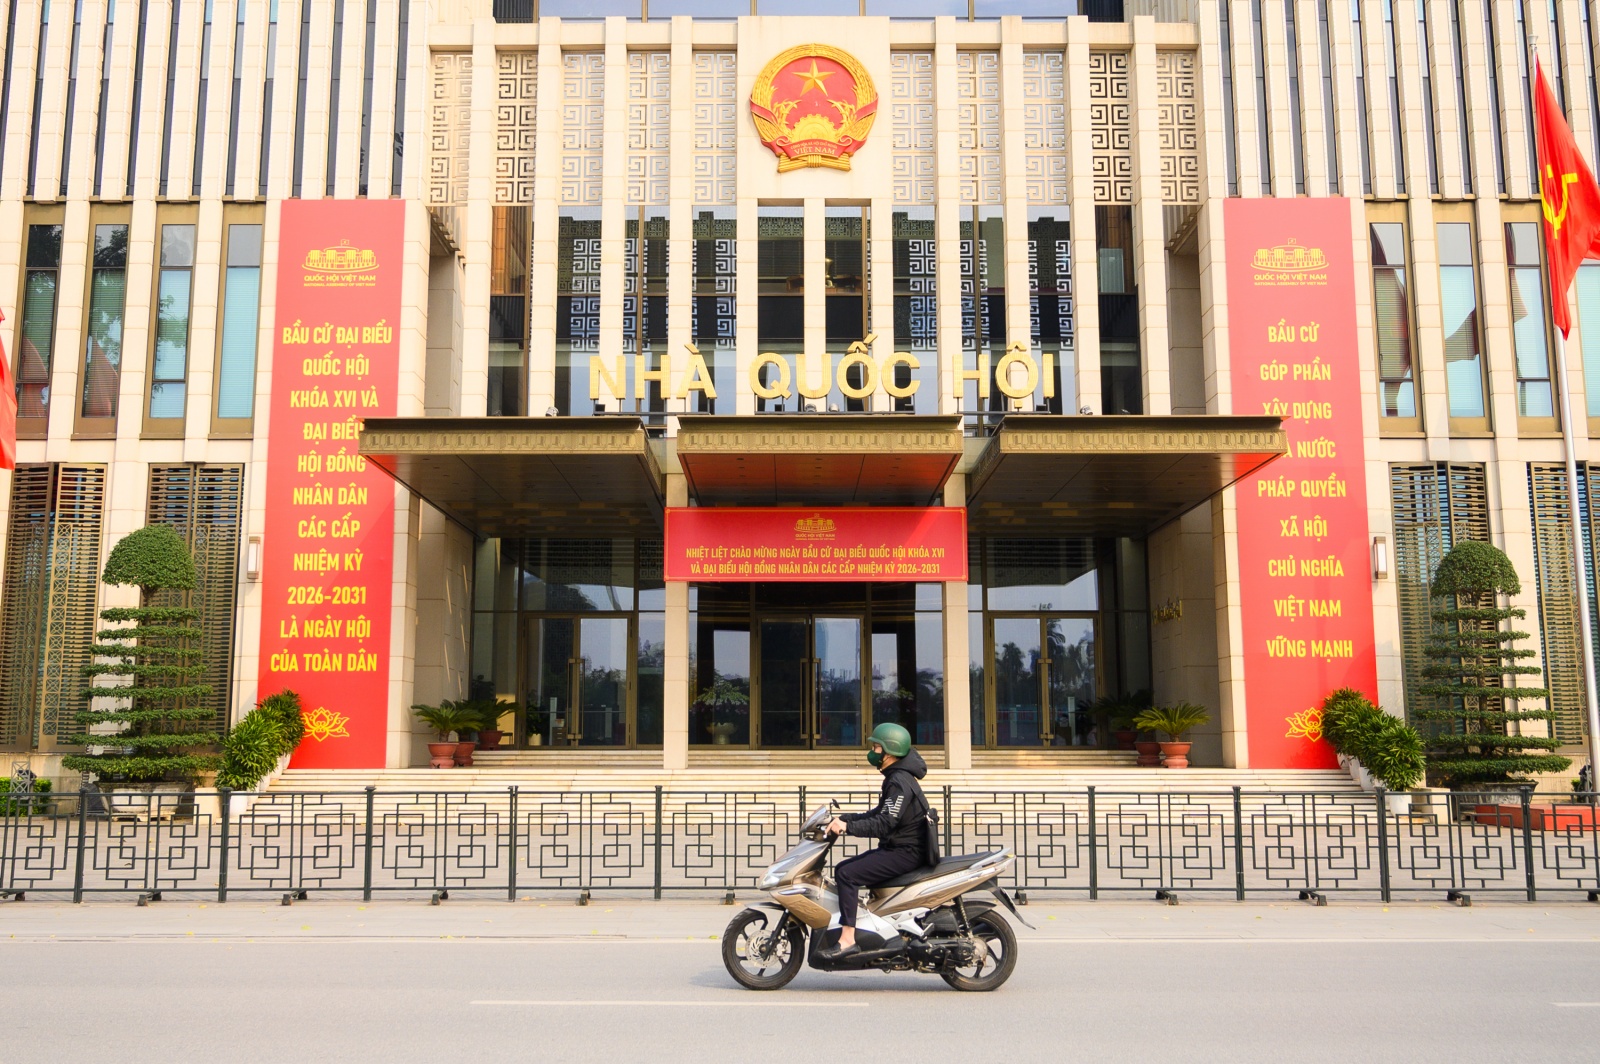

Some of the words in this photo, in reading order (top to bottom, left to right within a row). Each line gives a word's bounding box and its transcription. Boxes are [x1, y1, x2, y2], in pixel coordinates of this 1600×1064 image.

[814, 147, 835, 155] NAM
[304, 273, 325, 281] QUỐC
[326, 274, 339, 282] HỘI
[340, 274, 357, 282] VIỆT
[1254, 272, 1275, 280] QUỐC
[1276, 273, 1290, 281] HỘI
[1291, 273, 1308, 281] VIỆT
[283, 320, 309, 344] BẦU
[313, 322, 333, 344] CỬ
[336, 327, 358, 348] ĐẠI
[362, 320, 392, 344] BIỂU
[1268, 319, 1295, 342] BẦU
[1300, 321, 1320, 342] CỬ
[302, 351, 341, 376] QUỐC
[346, 354, 369, 380] HỘI
[589, 344, 718, 400] NHÀ
[748, 333, 921, 399] QUỐC
[952, 341, 1054, 408] HỘI
[1260, 360, 1288, 380] GÓP
[1293, 356, 1331, 380] PHẦN
[290, 386, 328, 407] KHÓA
[334, 390, 356, 407] XVI
[361, 386, 378, 407] VÀ
[1293, 401, 1332, 424] DỰNG
[303, 422, 327, 444] ĐẠI
[1297, 436, 1336, 458] NƯỚC
[298, 450, 322, 476] HỘI
[293, 483, 333, 504] NHÂN
[338, 483, 367, 505] DÂN
[1258, 476, 1296, 497] PHÁP
[1301, 473, 1346, 497] QUYỀN
[298, 516, 326, 538] CÁC
[331, 512, 360, 538] CẤP
[1280, 516, 1299, 536] XÃ
[1304, 515, 1328, 542] HỘI
[294, 548, 339, 576] NHIỆM
[344, 548, 363, 570] KỲ
[686, 545, 709, 560] NHIỆT
[712, 545, 728, 560] LIỆT
[730, 546, 751, 558] CHÀO
[754, 546, 777, 558] MỪNG
[780, 546, 801, 558] NGÀY
[803, 544, 819, 558] BẦU
[821, 546, 831, 558] CỬ
[834, 548, 847, 560] ĐẠI
[850, 544, 867, 558] BIỂU
[870, 544, 890, 558] QUỐC
[893, 545, 907, 560] HỘI
[908, 546, 930, 558] KHÓA
[932, 548, 945, 558] XVI
[691, 562, 701, 574] VÀ
[703, 564, 717, 576] ĐẠI
[718, 560, 737, 574] BIỂU
[738, 562, 753, 576] HỘI
[753, 560, 776, 574] ĐỒNG
[778, 562, 801, 574] NHÂN
[802, 562, 819, 574] DÂN
[821, 562, 837, 574] CÁC
[839, 560, 855, 574] CẤP
[857, 562, 883, 576] NHIỆM
[884, 562, 895, 574] KỲ
[897, 564, 940, 574] 2026-2031
[1268, 555, 1296, 576] CHỦ
[1301, 555, 1344, 576] NGHĨA
[288, 586, 366, 604] 2026-2031
[1274, 595, 1305, 622] VIỆT
[1309, 600, 1341, 616] NAM
[280, 615, 298, 638] LÀ
[304, 615, 342, 638] NGÀY
[346, 615, 370, 642] HỘI
[271, 649, 298, 672] CỦA
[304, 650, 342, 671] TOÀN
[348, 649, 376, 671] DÂN
[1266, 636, 1306, 657] VỮNG
[1311, 640, 1353, 662] MẠNH
